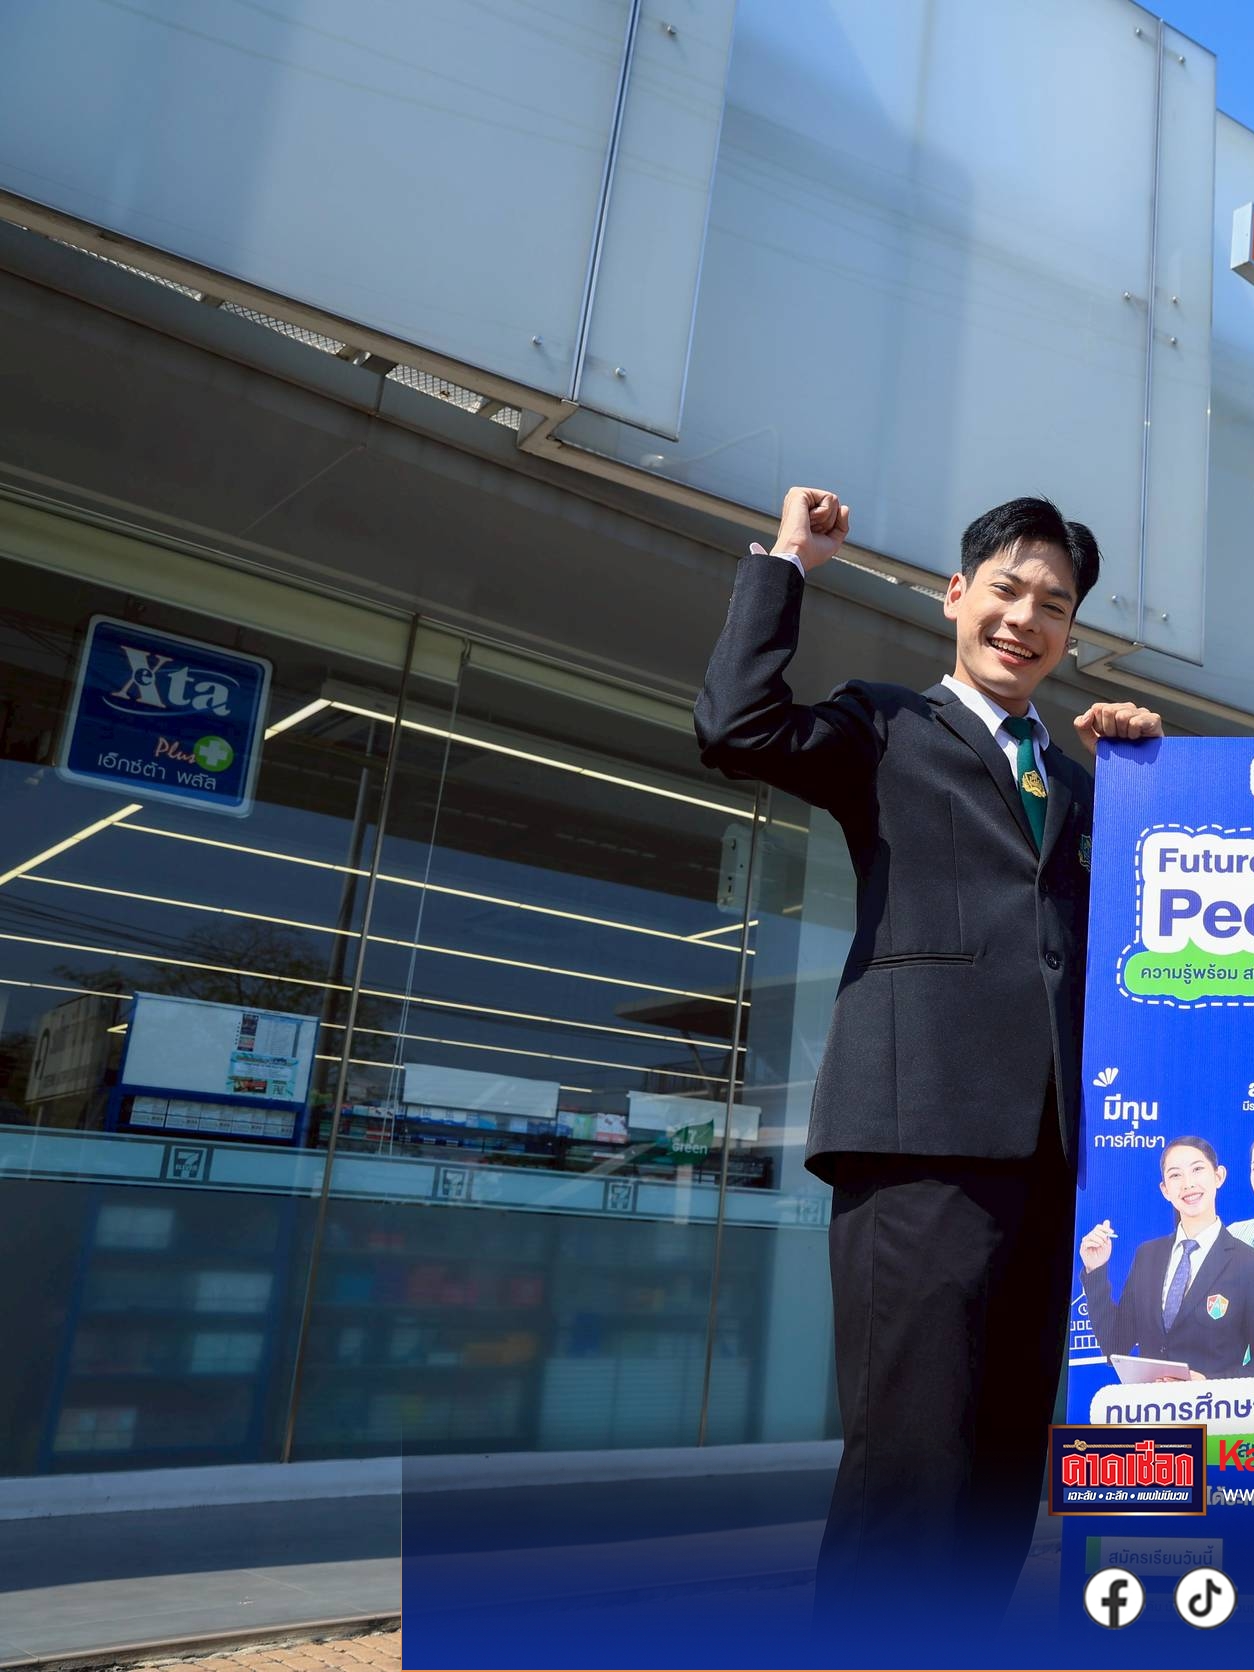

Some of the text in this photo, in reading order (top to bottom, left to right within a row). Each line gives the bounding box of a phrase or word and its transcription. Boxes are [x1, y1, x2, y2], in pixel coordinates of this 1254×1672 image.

[155, 737, 196, 763] Plus
[1140, 963, 1238, 985] ความรู้พร้อม
[1104, 1093, 1158, 1129] มีทุน
[672, 1142, 708, 1155] Green
[1094, 1130, 1166, 1148] การศึกษา
[1109, 1545, 1214, 1566] สมัครเรียนวันนี้
